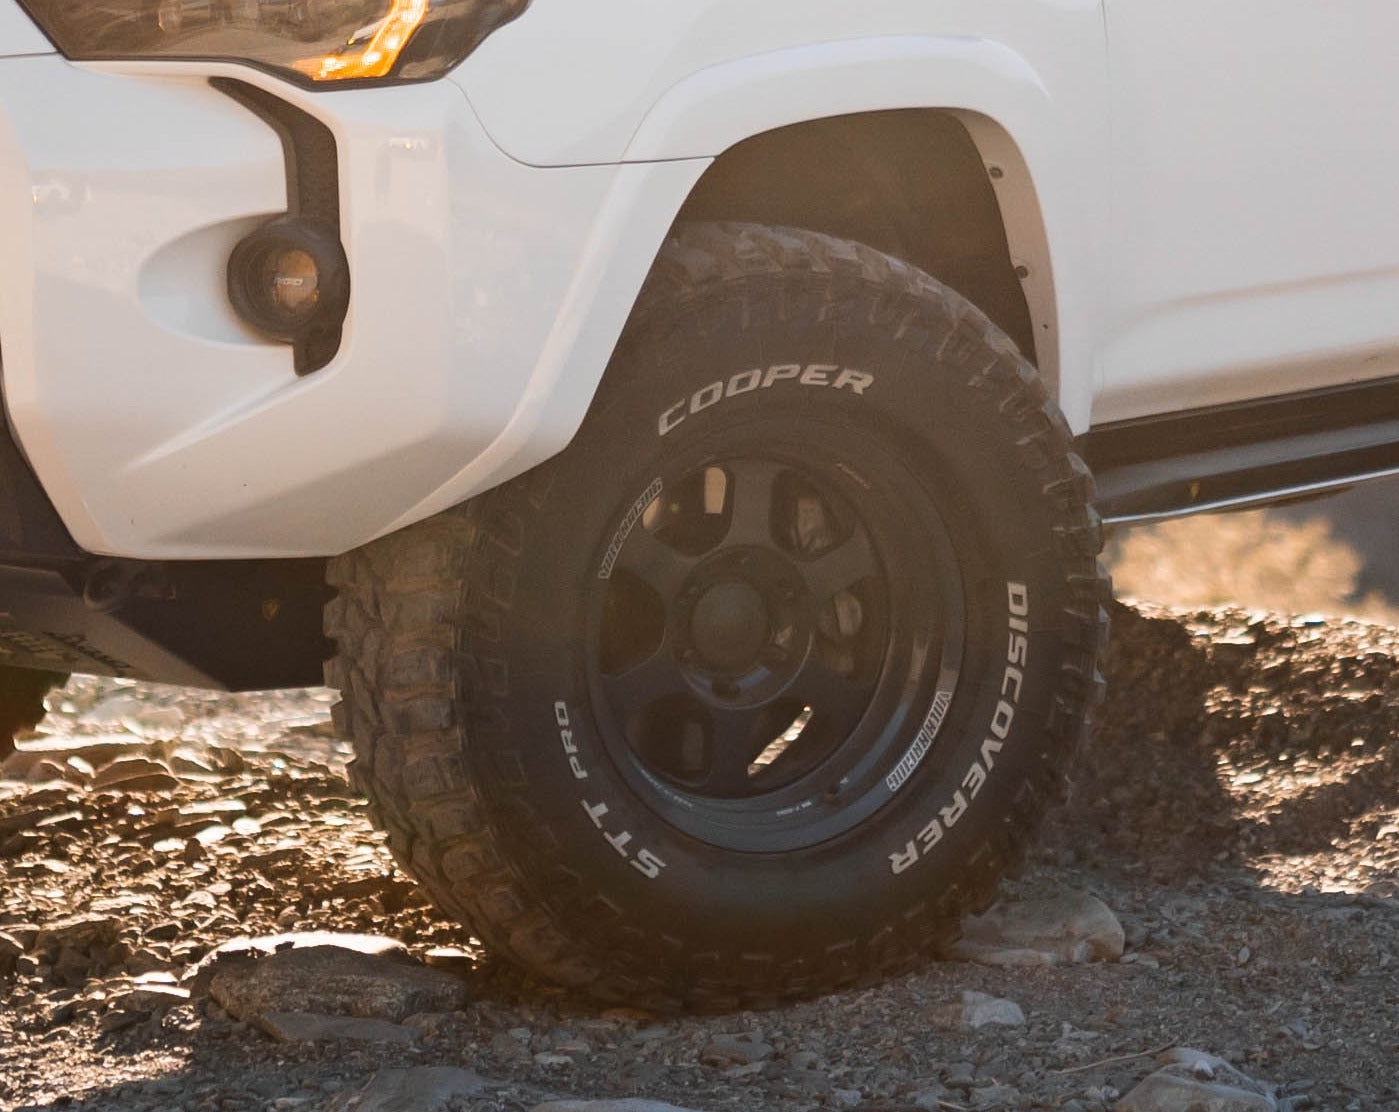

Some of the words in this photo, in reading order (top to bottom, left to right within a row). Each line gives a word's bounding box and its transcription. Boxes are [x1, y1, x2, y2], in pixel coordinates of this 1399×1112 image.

[658, 363, 875, 437] COOPER
[554, 701, 589, 780] PRO
[887, 580, 1029, 876] DISCOVERER
[580, 799, 667, 879] STT
